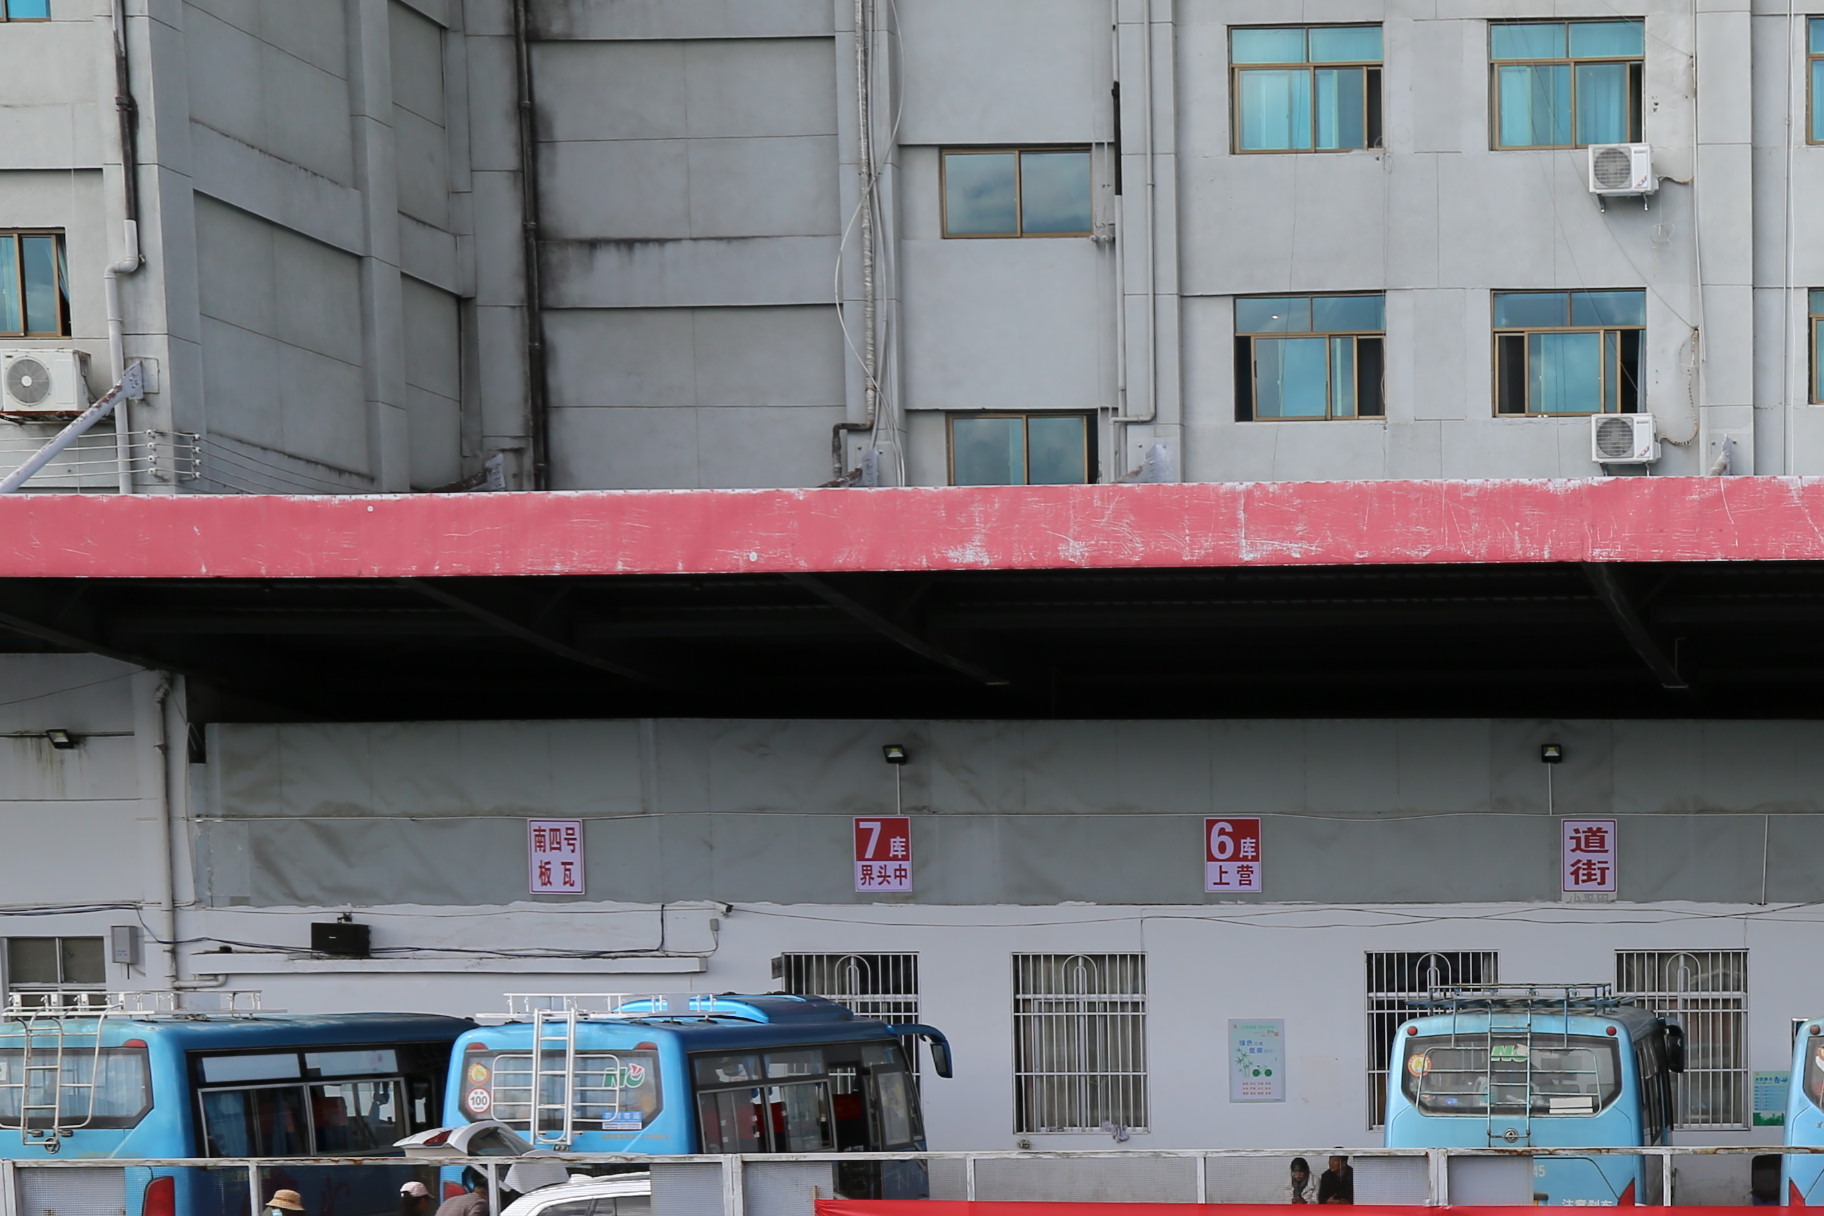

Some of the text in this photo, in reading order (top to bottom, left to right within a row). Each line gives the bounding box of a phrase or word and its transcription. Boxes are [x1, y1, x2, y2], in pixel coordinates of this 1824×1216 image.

[533, 827, 578, 854] 南四号
[859, 822, 907, 859] 7库
[1210, 822, 1257, 860] 6库
[860, 864, 908, 887] 界头中
[470, 1096, 488, 1106] 100
